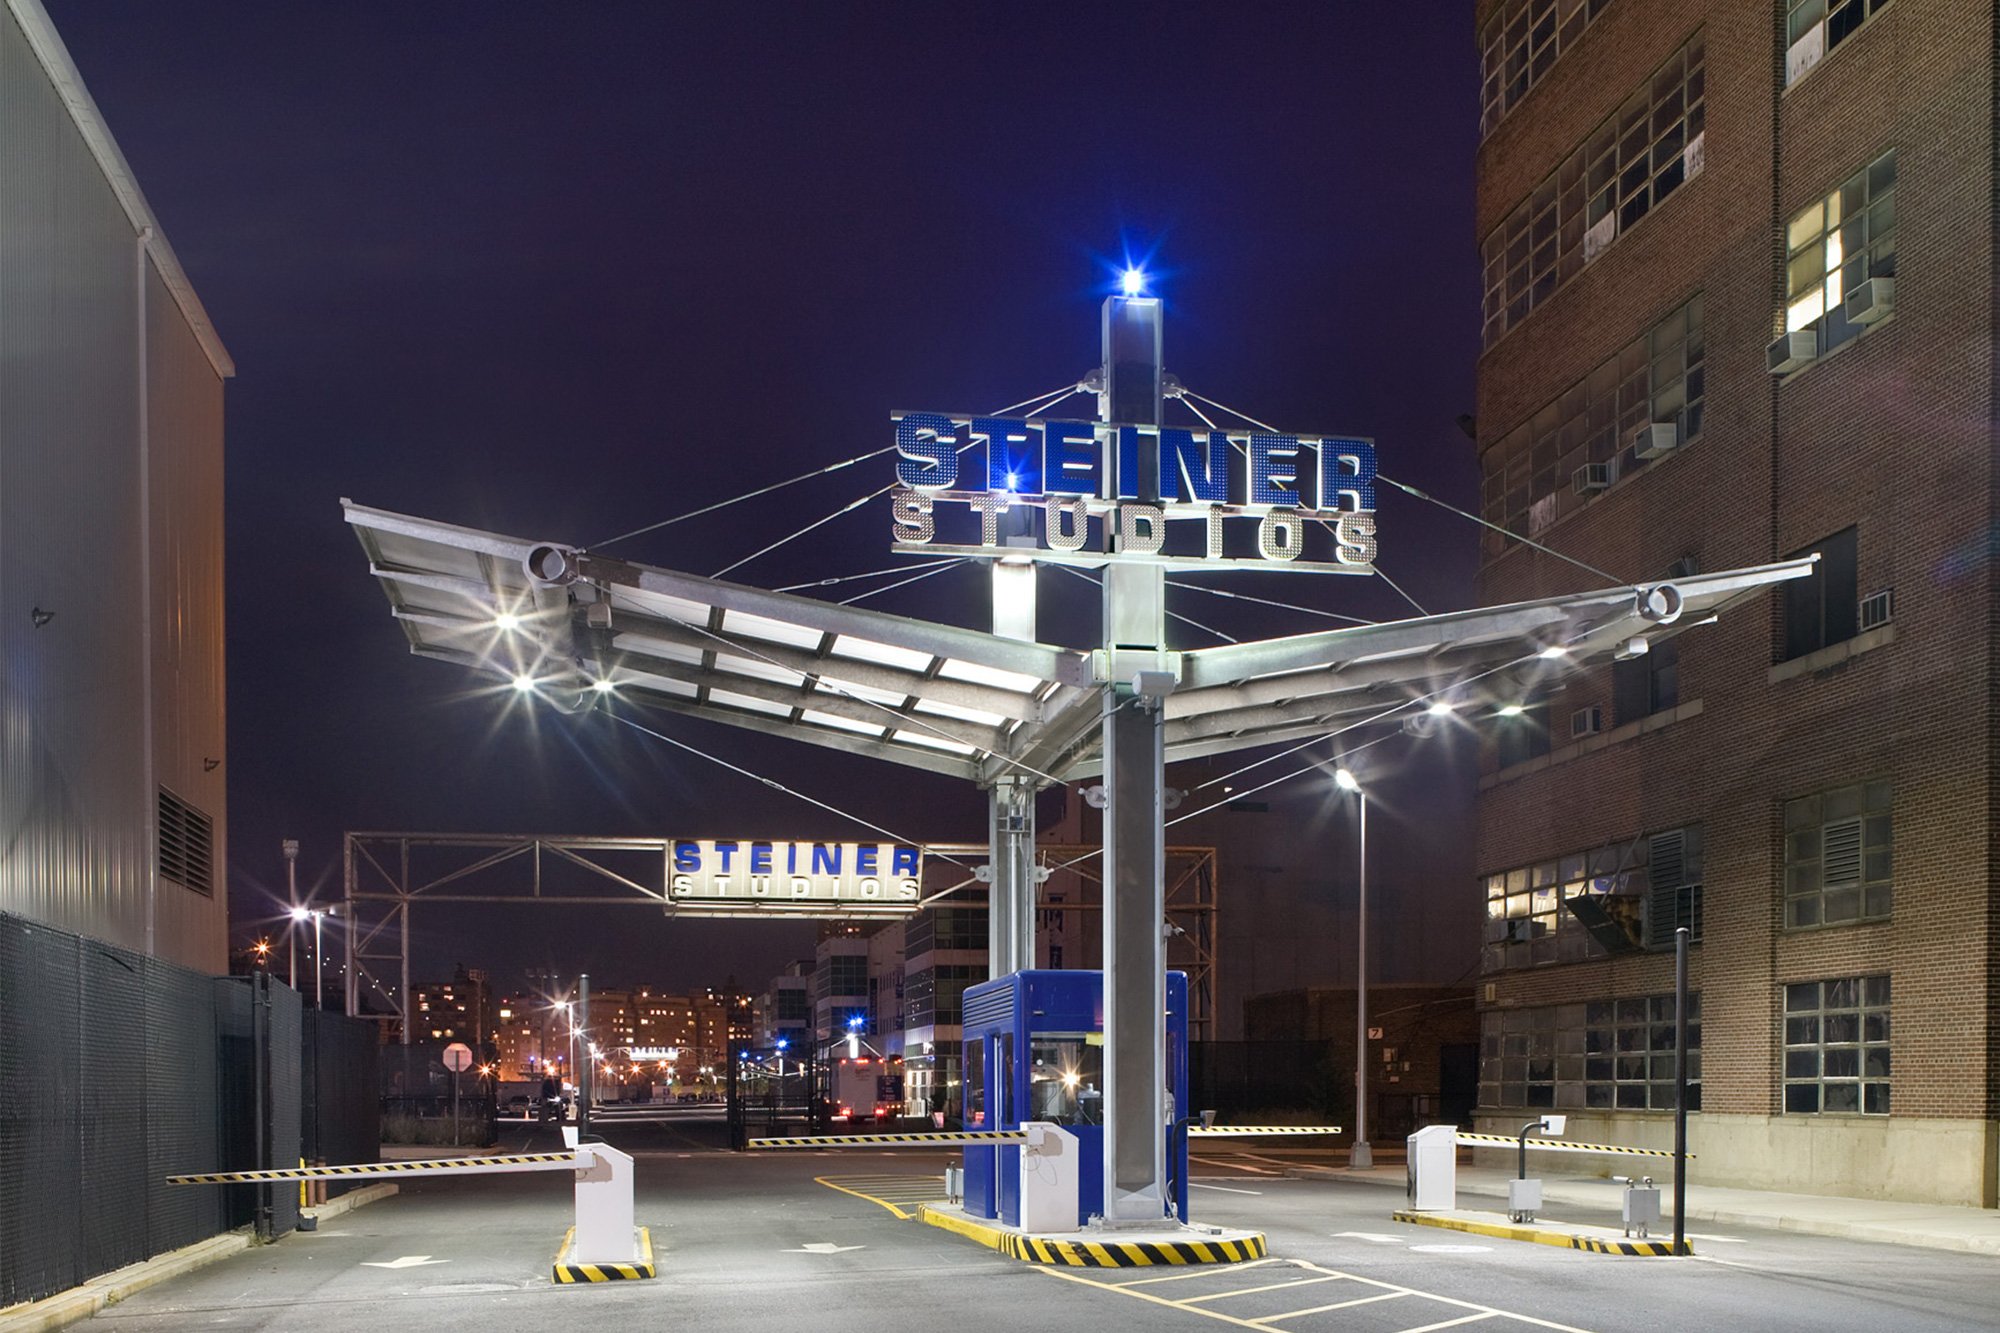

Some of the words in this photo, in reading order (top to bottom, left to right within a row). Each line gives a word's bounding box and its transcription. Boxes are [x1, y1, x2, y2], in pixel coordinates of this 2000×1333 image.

[895, 413, 1378, 512] STEINER
[892, 491, 1377, 565] STUDIOS
[674, 841, 919, 877] STEINER
[673, 875, 918, 899] STUDIOS
